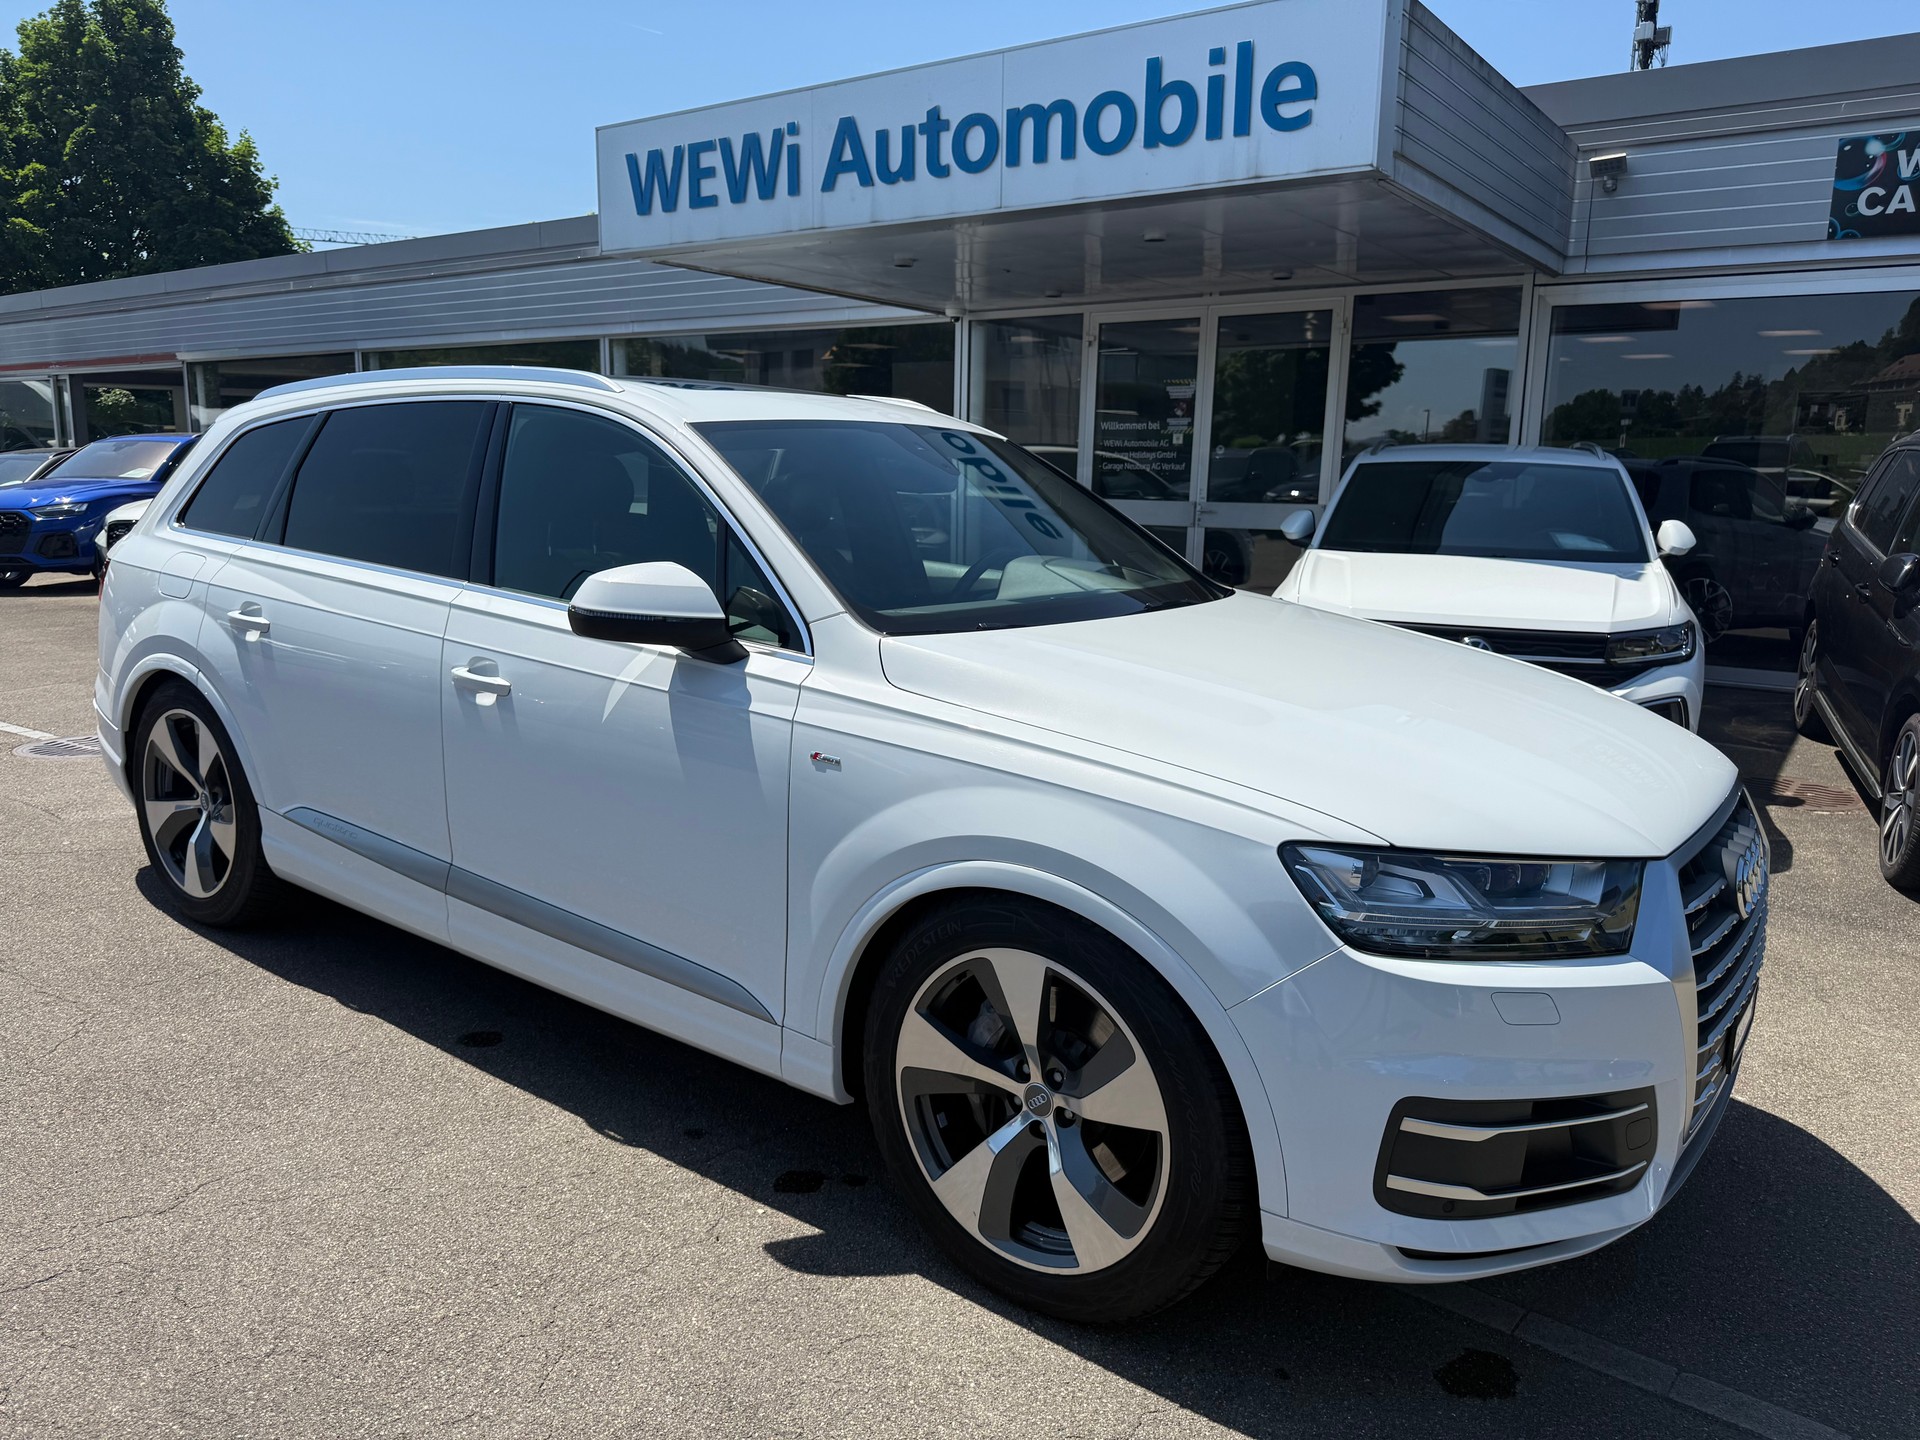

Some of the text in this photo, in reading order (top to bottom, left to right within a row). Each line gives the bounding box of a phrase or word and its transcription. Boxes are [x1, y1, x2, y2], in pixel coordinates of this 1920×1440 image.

[625, 40, 1318, 216] WEWi Automobile
[1857, 185, 1916, 217] CA
[1100, 421, 1147, 431] Willkommen
[1148, 420, 1160, 430] bei
[1123, 439, 1159, 447] Automobile
[1159, 439, 1169, 447] AG
[1156, 451, 1177, 459] GmbH
[1102, 462, 1124, 471] Garage
[1161, 462, 1186, 471] Verkauf
